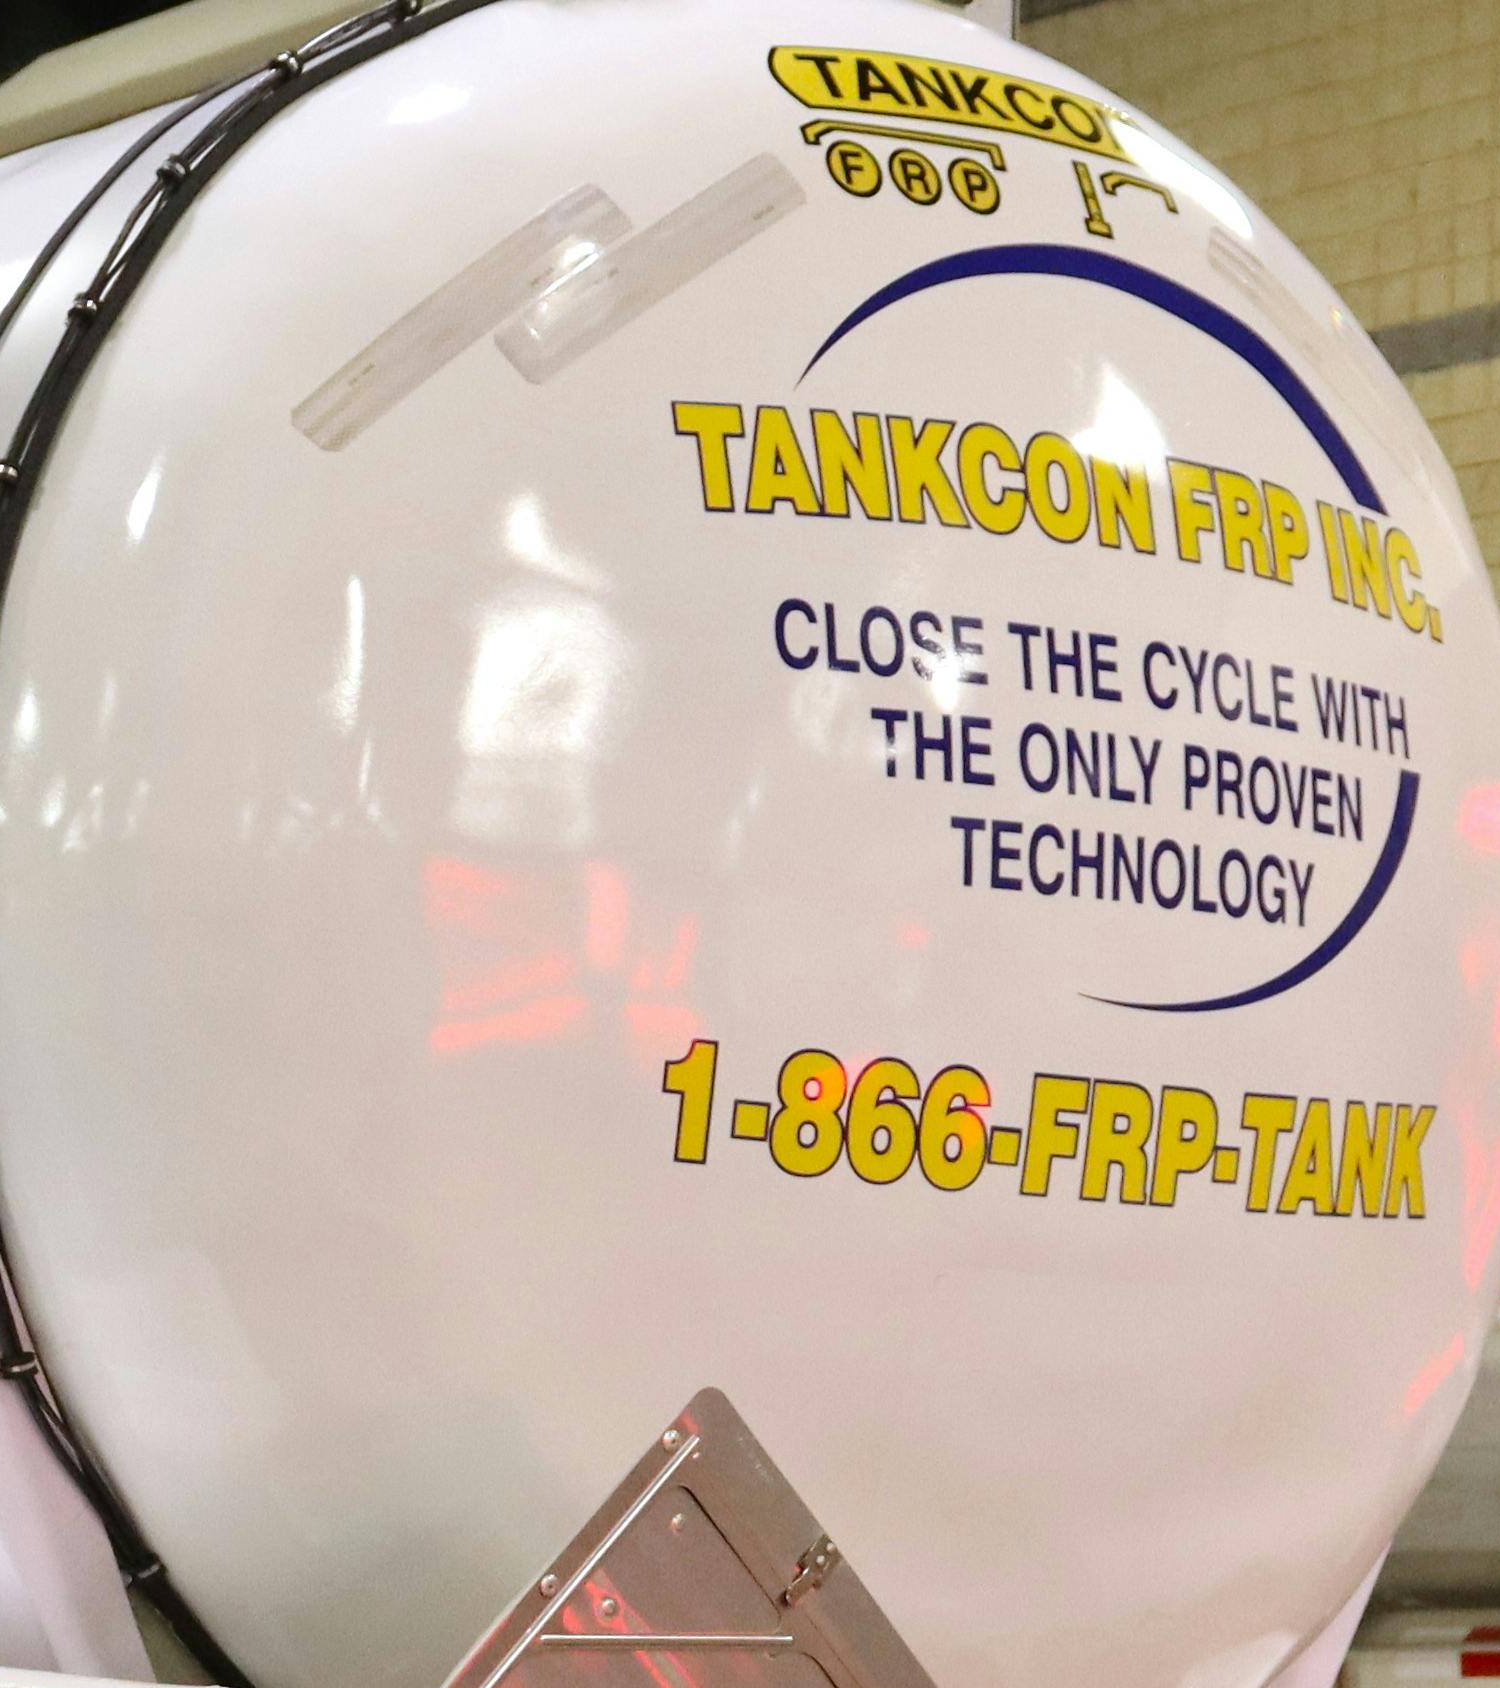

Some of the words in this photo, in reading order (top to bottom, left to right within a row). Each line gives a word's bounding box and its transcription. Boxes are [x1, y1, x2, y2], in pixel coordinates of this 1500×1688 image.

[671, 401, 1156, 554] TANKCON
[1166, 455, 1310, 585] FRP
[1316, 499, 1443, 643] INC.
[774, 597, 988, 686] CLOSE
[1008, 621, 1122, 702] THE
[1143, 641, 1298, 732] CYCLE
[1311, 672, 1409, 759] WITH
[871, 707, 995, 786] THE
[1020, 721, 1162, 804] ONLY
[1184, 743, 1363, 842] PROVEN
[951, 816, 1314, 927] TECHNOLOGY
[662, 1038, 1437, 1219] 1-866-FRP-TANK
